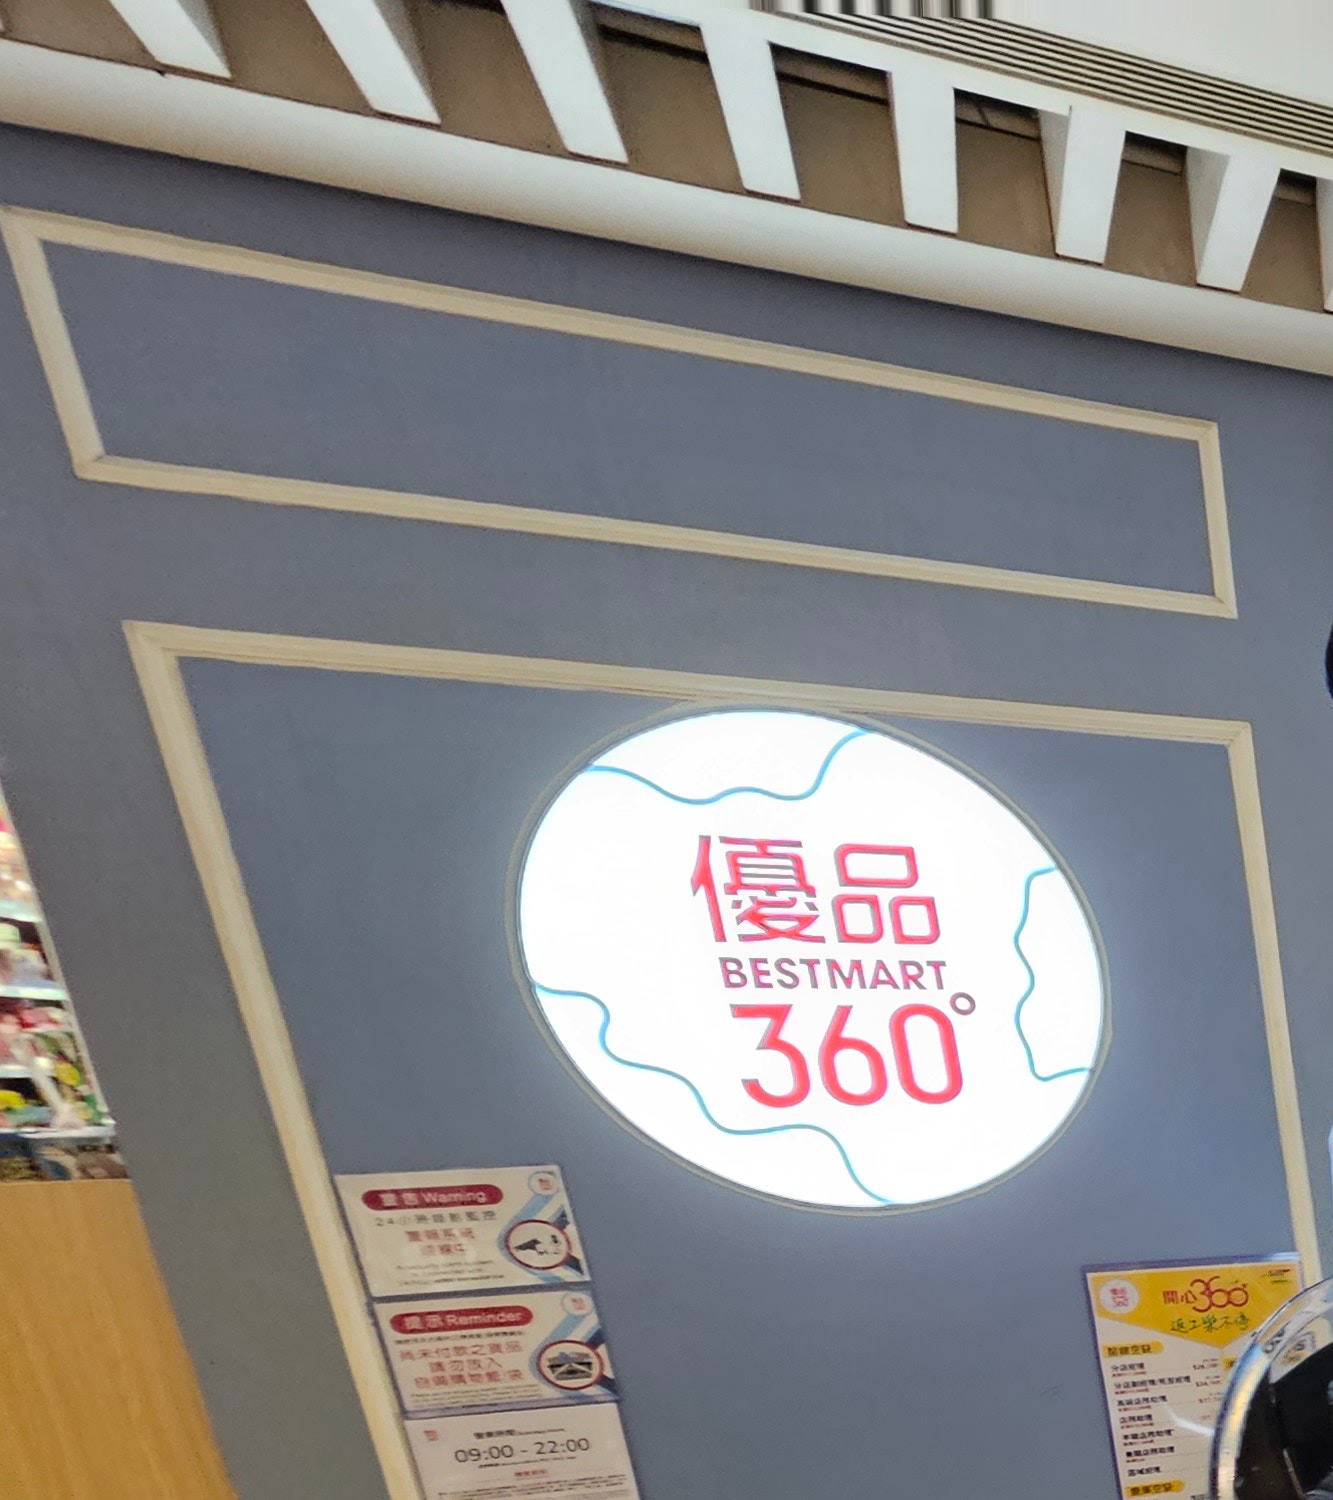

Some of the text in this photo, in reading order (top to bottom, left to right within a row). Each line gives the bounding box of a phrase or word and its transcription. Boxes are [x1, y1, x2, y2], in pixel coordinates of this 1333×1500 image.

[690, 834, 942, 946] 優品
[718, 956, 947, 991] BESTMART
[422, 1190, 488, 1204] Warning
[446, 1310, 524, 1326] Reminder
[454, 1444, 514, 1463] 09:00
[534, 1437, 591, 1456] 22:00
